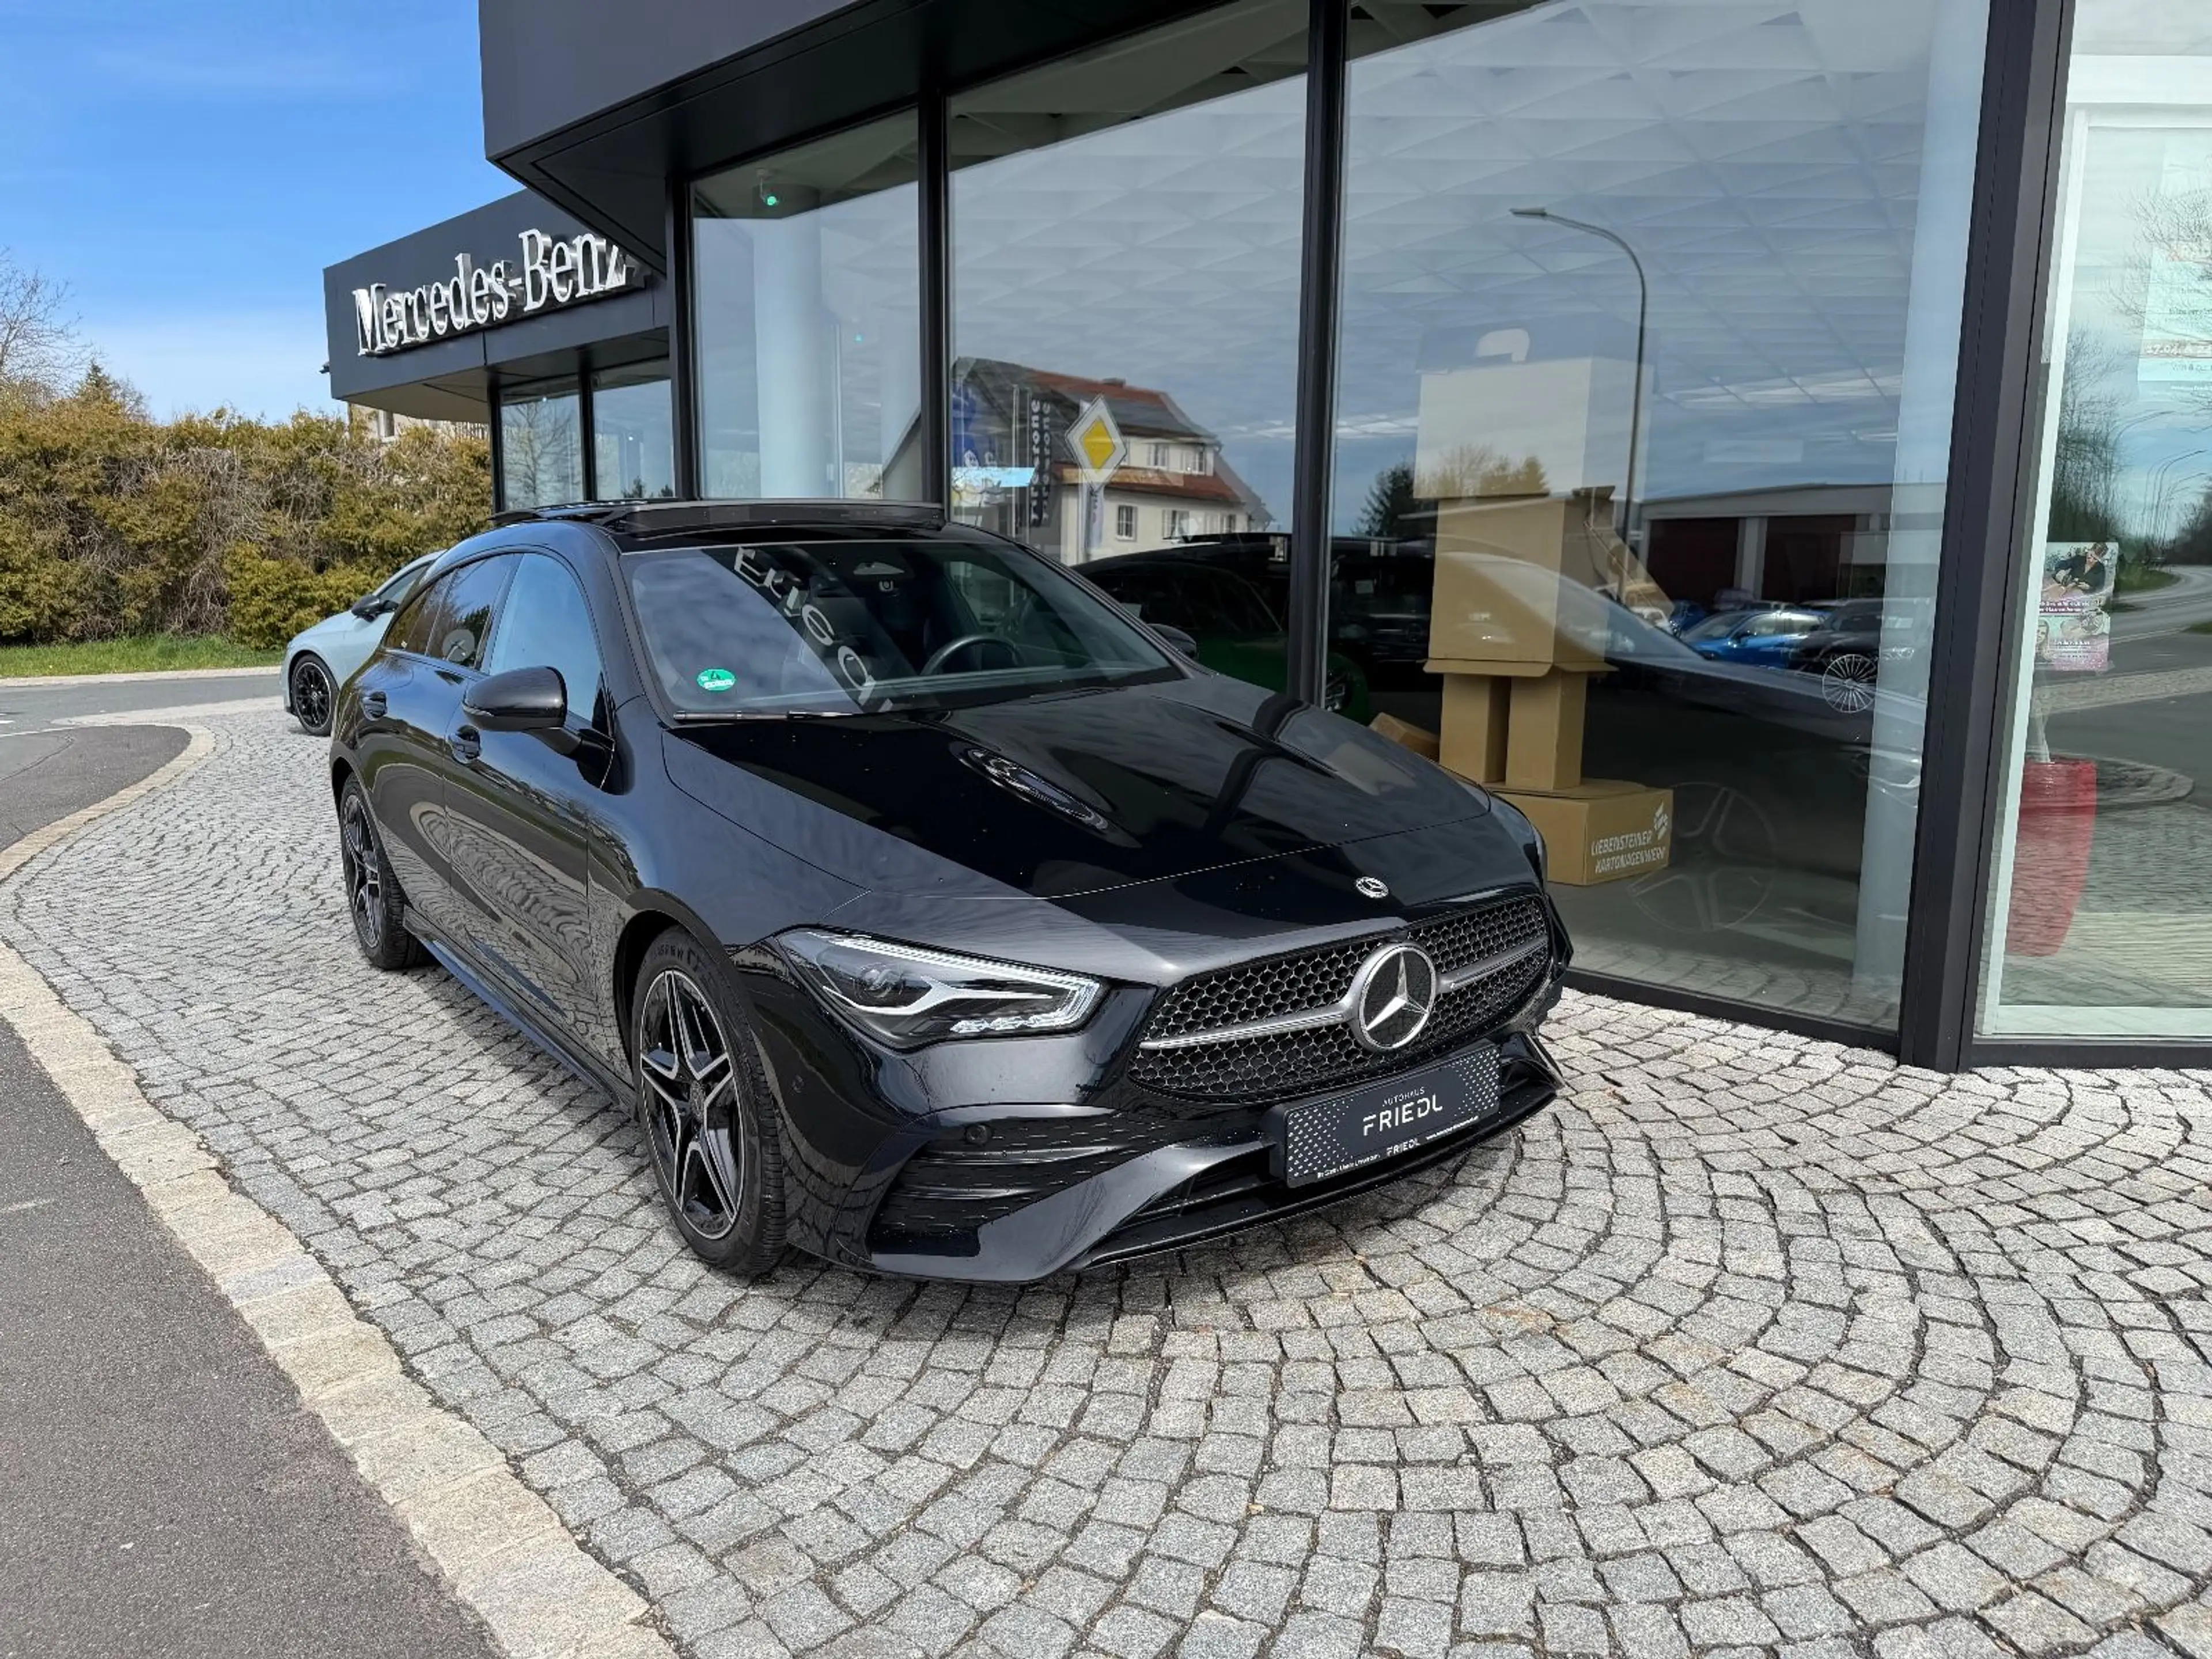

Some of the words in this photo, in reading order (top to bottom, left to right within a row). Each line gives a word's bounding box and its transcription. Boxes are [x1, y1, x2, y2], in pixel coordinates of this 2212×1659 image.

[352, 228, 628, 357] Mercedes-Benz
[1592, 830, 1653, 856] LIEBENSTEINER
[1382, 1086, 1425, 1107] AUTOHAUS
[1363, 1094, 1444, 1137] FRIEDL
[1387, 1138, 1421, 1157] FRIEDL
